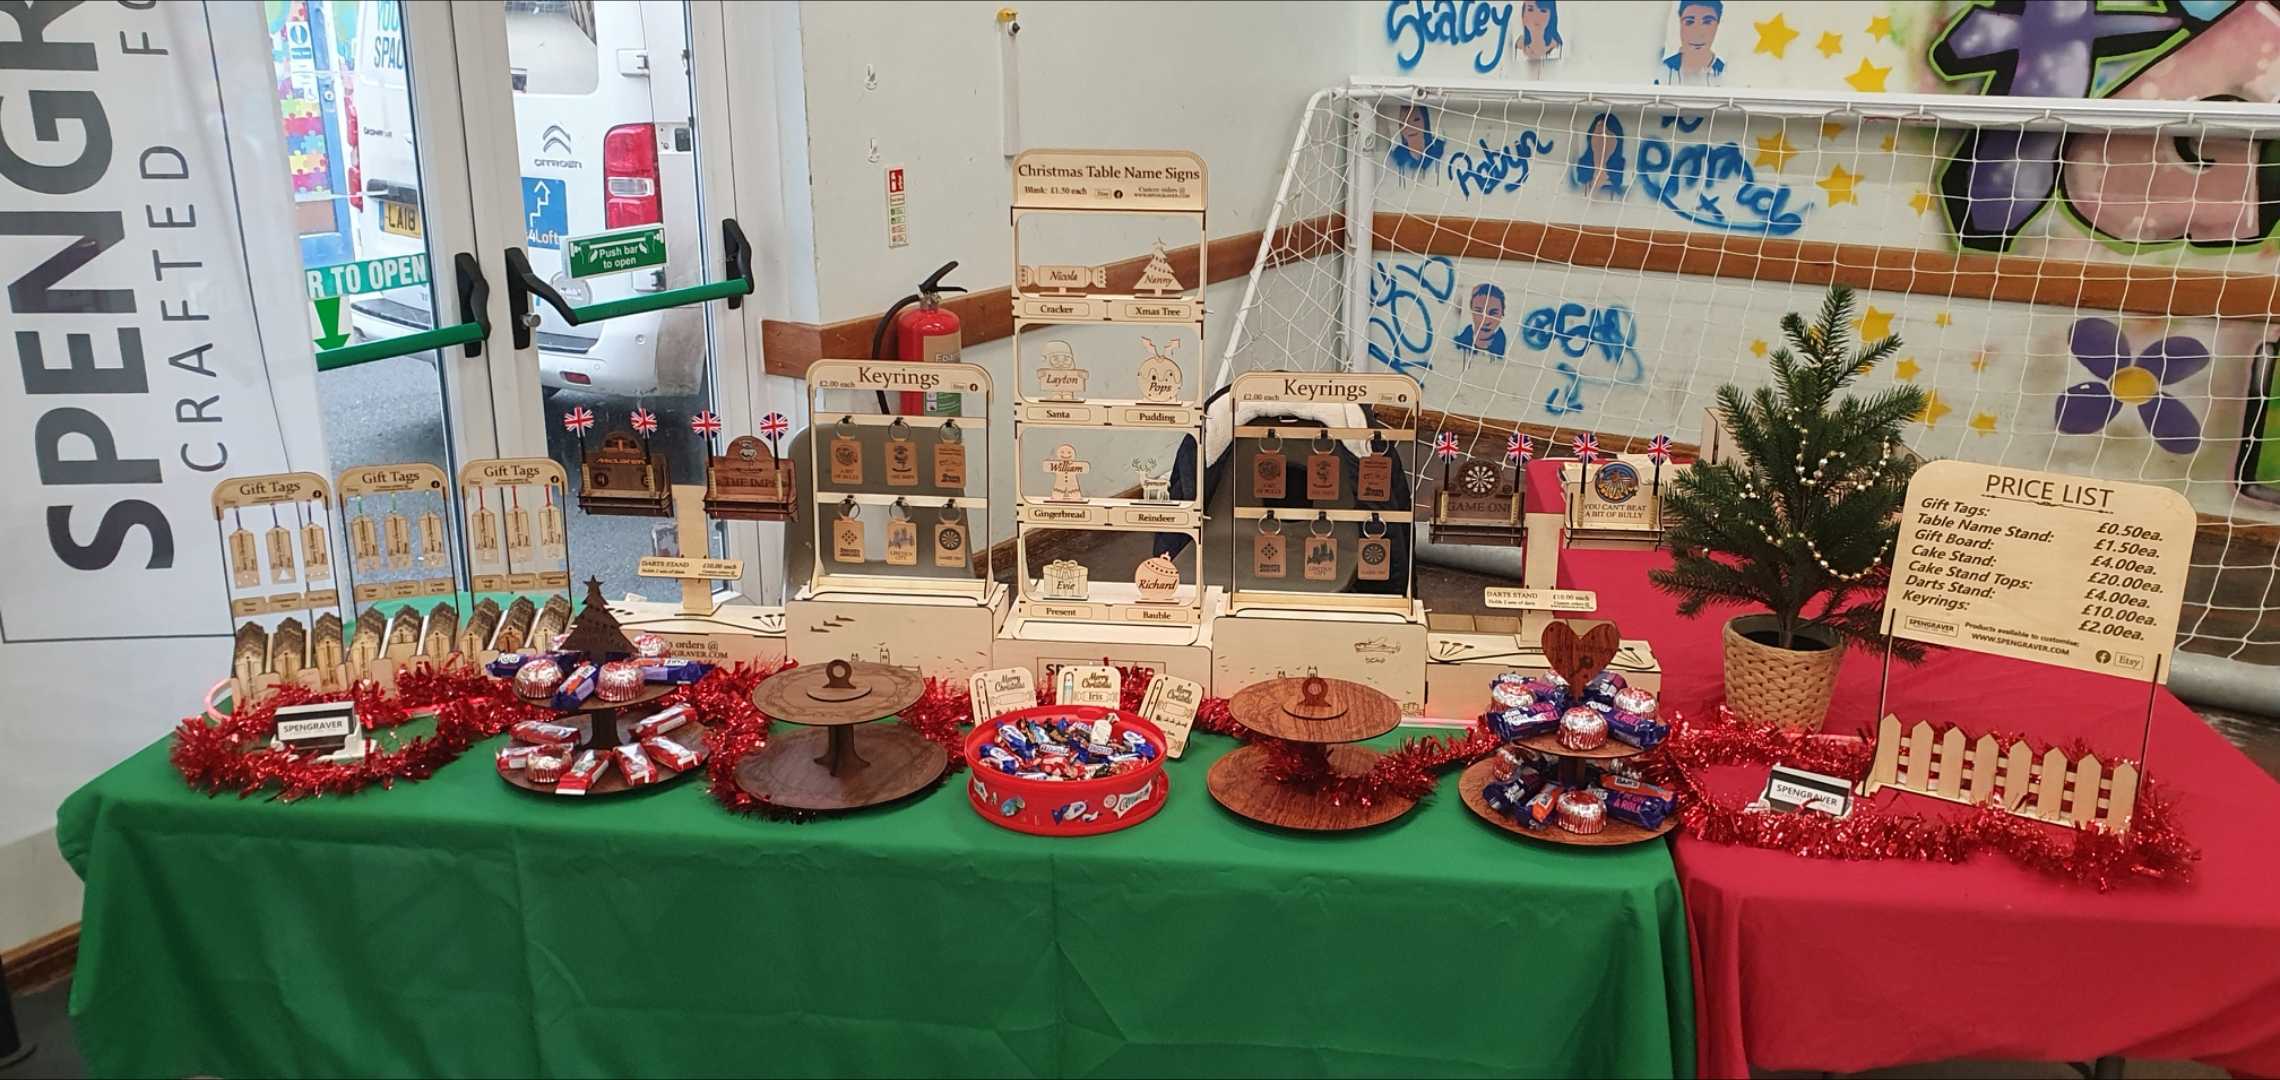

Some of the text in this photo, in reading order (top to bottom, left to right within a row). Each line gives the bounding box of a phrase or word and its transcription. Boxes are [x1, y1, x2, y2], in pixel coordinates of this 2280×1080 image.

[1386, 0, 1512, 73] Stacey
[374, 36, 404, 69] SPAC
[1018, 164, 1200, 182] Christmas Table Name Signs
[1050, 186, 1070, 195] £1.50
[1071, 187, 1087, 195] each
[600, 243, 639, 258] Push bar
[603, 257, 637, 270] to open
[331, 264, 361, 294] TO
[368, 254, 427, 290] OPEN
[1049, 270, 1078, 281] Nicola
[1144, 274, 1173, 287] Nanny
[0, 0, 174, 571] SPENGR
[140, 146, 227, 472] CRAFTED
[1039, 304, 1074, 314] Cracker
[1135, 306, 1181, 317] Xmas Tree
[858, 366, 940, 389] Keyrings
[1046, 373, 1079, 387] Layton
[1149, 381, 1172, 394] Pops
[1284, 378, 1367, 401] Keyrings
[1046, 409, 1071, 419] Santa
[1139, 412, 1176, 424] Pudding
[484, 464, 540, 479] Gift Tags
[1050, 461, 1084, 473] William
[362, 470, 421, 484] Gift Tags
[239, 480, 301, 496] Gift Tags
[1986, 473, 2115, 508] PRICE LIST
[1447, 501, 1485, 512] GAME
[1584, 503, 1600, 511] YOU
[1627, 504, 1648, 512] BEAT
[1034, 508, 1086, 520] Gingerbread
[1138, 513, 1176, 523] Reindeer
[1921, 497, 2163, 542] Gift Tags: £0.50ea.
[1917, 513, 2160, 558] Table Name Stand: £1.50ea.
[1914, 528, 2157, 575] Gift Board: £4.00ea.
[1911, 544, 2164, 593] Cake Stand: £20.00ea.
[1056, 579, 1076, 591] Evie
[1138, 578, 1177, 591] Richard
[1908, 560, 2150, 609] Cake Stand Tops: £4.00ea.
[1905, 574, 2157, 626] Darts Stand: £10.00ea.
[1046, 606, 1077, 617] Present
[1143, 610, 1172, 620] Bauble
[1902, 589, 2144, 641] Keyrings: £2.00ea.
[1909, 618, 1955, 632] SPENGRAVER
[1964, 621, 1996, 634] Products
[1997, 627, 2029, 639] available
[2031, 632, 2039, 640] to
[675, 640, 719, 650] orders @
[1971, 633, 2070, 656] WWW.SPENGRAVER.COM
[669, 650, 728, 659] NGRAVER.COM
[2118, 655, 2141, 667] Etsy
[1088, 671, 1109, 682] Merry
[283, 720, 343, 733] SPENGRAVER
[1776, 784, 1838, 806] SPENGRAVER
